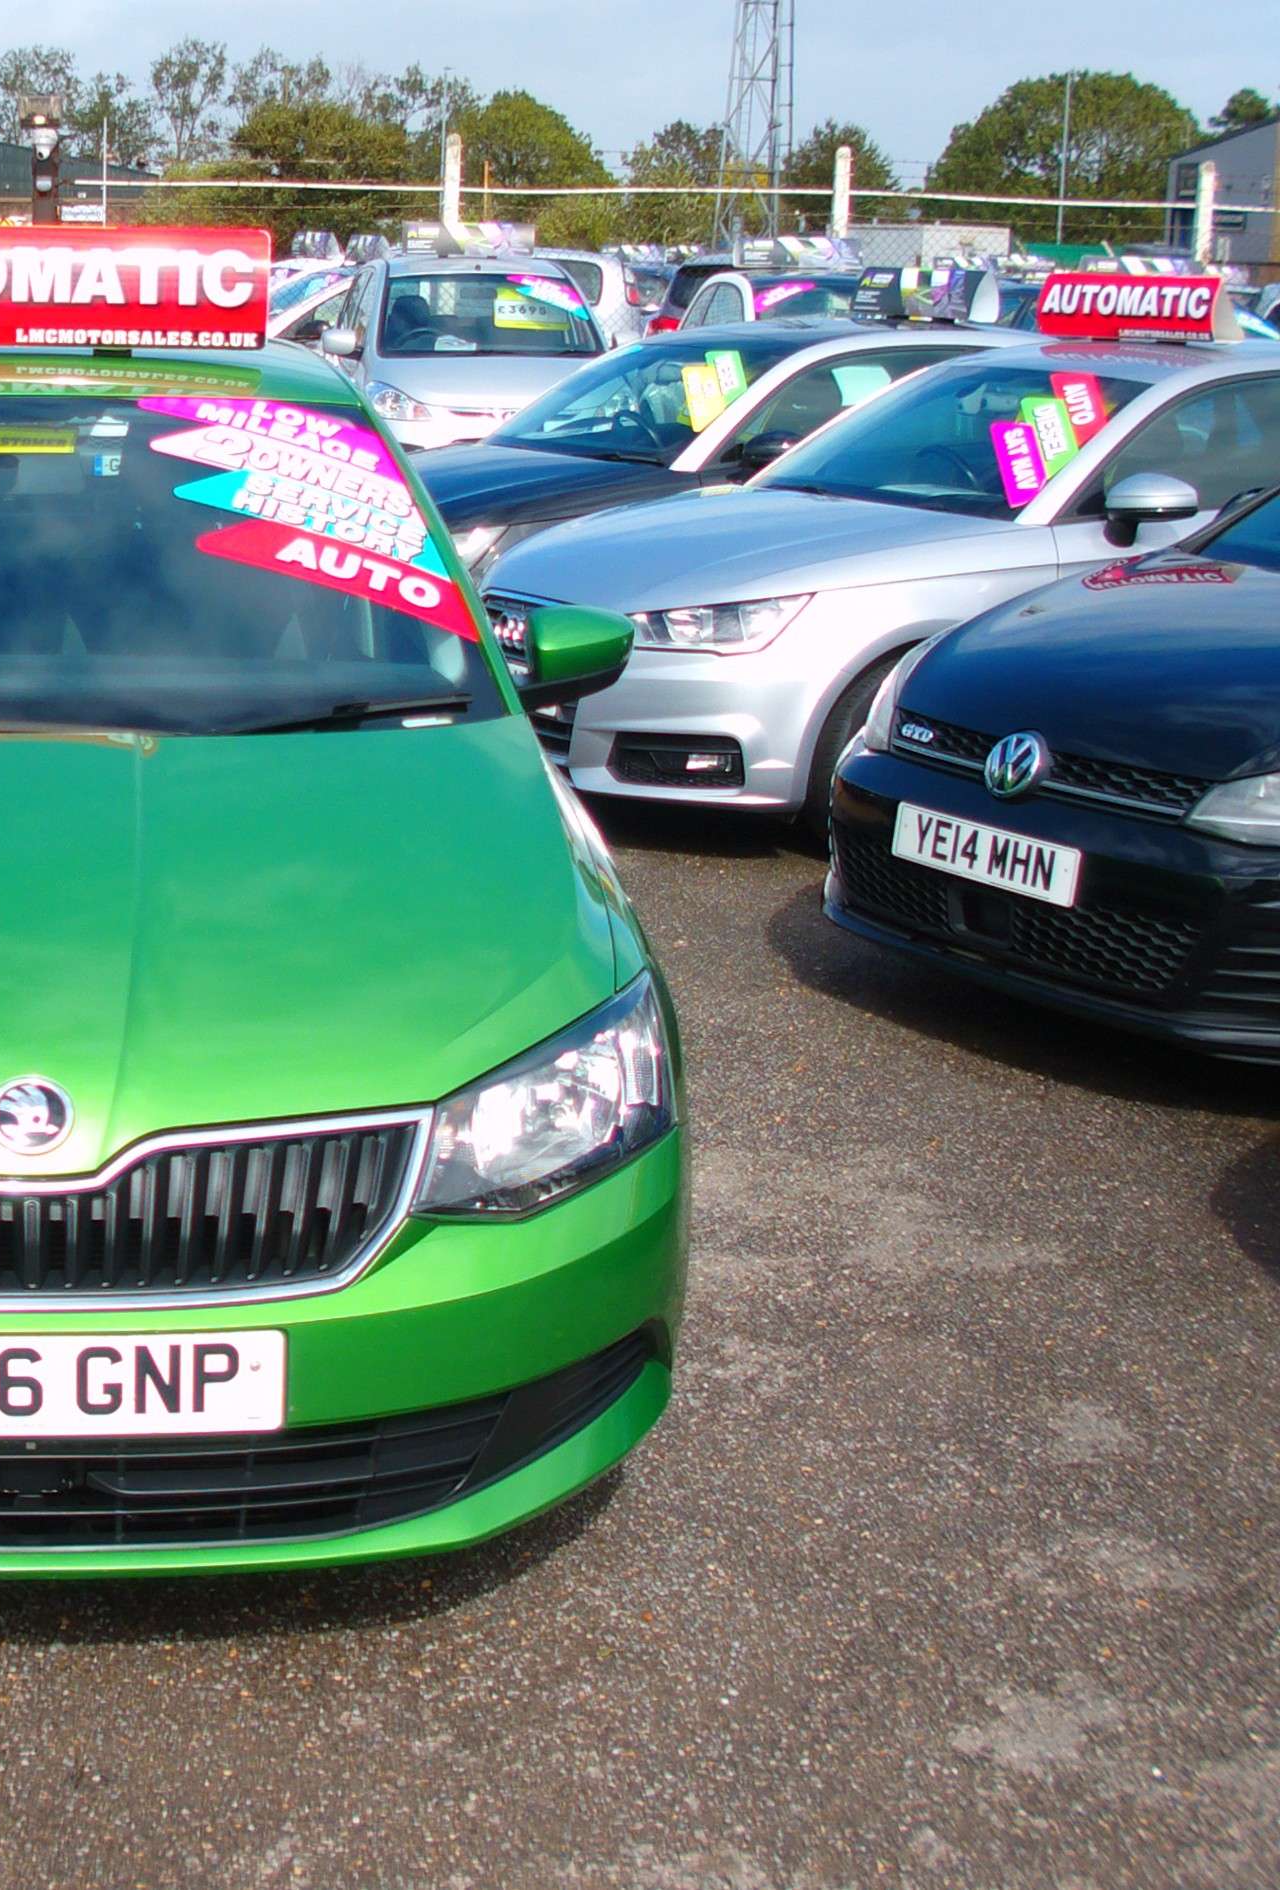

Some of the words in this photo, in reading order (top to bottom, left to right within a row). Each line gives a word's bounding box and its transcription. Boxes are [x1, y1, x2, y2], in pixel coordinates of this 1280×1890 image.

[1041, 283, 1211, 320] AUTOMATIC
[16, 328, 259, 349] LMCMOTORSALES.CO.UK
[251, 401, 343, 439] LOW
[1032, 402, 1070, 462] DIESEL
[1062, 383, 1096, 425] AUTO
[195, 402, 381, 472] MILEAGE
[1003, 427, 1030, 456] SAT
[1010, 455, 1040, 490] NAV
[231, 489, 424, 563] HISTORY
[246, 471, 427, 547] SERVICE
[275, 538, 441, 608] AUTO
[916, 812, 979, 872] YE14
[986, 834, 1057, 893] MHN
[75, 1342, 240, 1416] GNP
